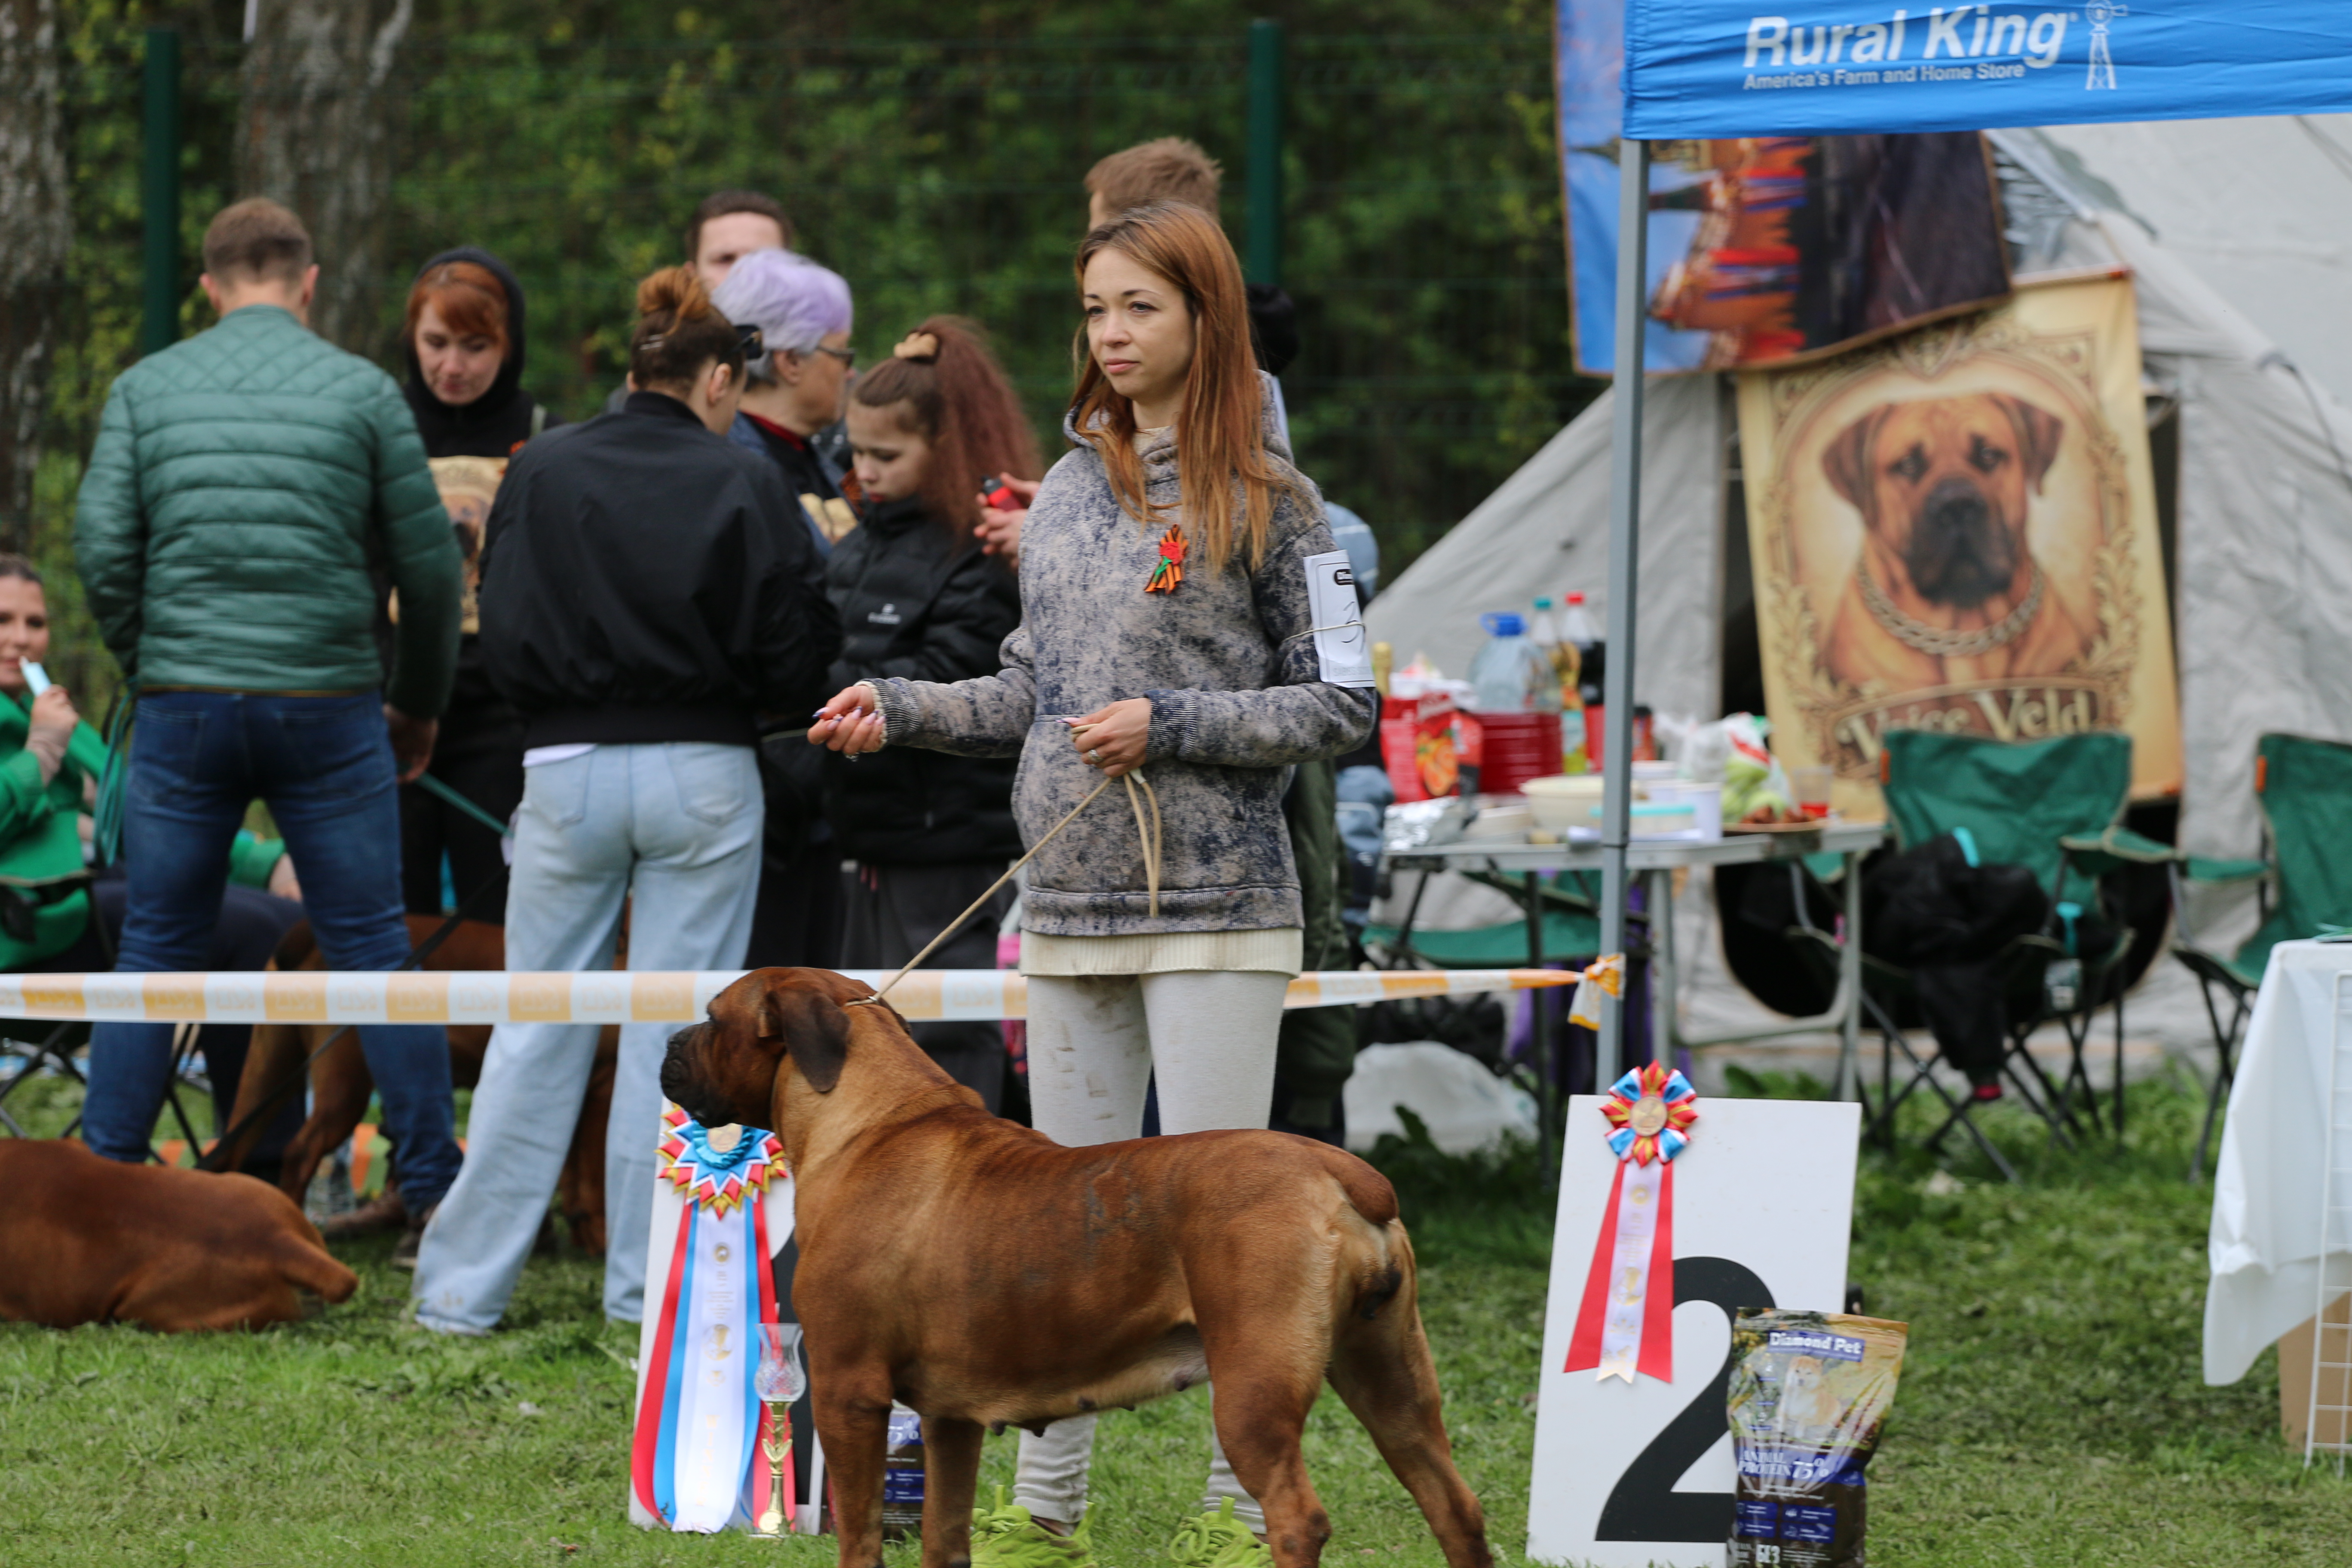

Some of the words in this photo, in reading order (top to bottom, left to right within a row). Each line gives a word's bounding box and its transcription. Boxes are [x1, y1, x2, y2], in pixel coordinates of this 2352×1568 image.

[1743, 9, 1907, 68] Rural
[1923, 5, 2068, 69] King
[1743, 69, 1830, 90] America's
[1834, 69, 1879, 86] Farm
[1883, 66, 1917, 84] and
[1920, 64, 1973, 83] Home
[1976, 62, 2025, 80] Store
[1966, 687, 2092, 742] Veld
[1769, 1332, 1833, 1350] Diamond
[1833, 1337, 1862, 1354] Pet
[1594, 1256, 1777, 1543] 2
